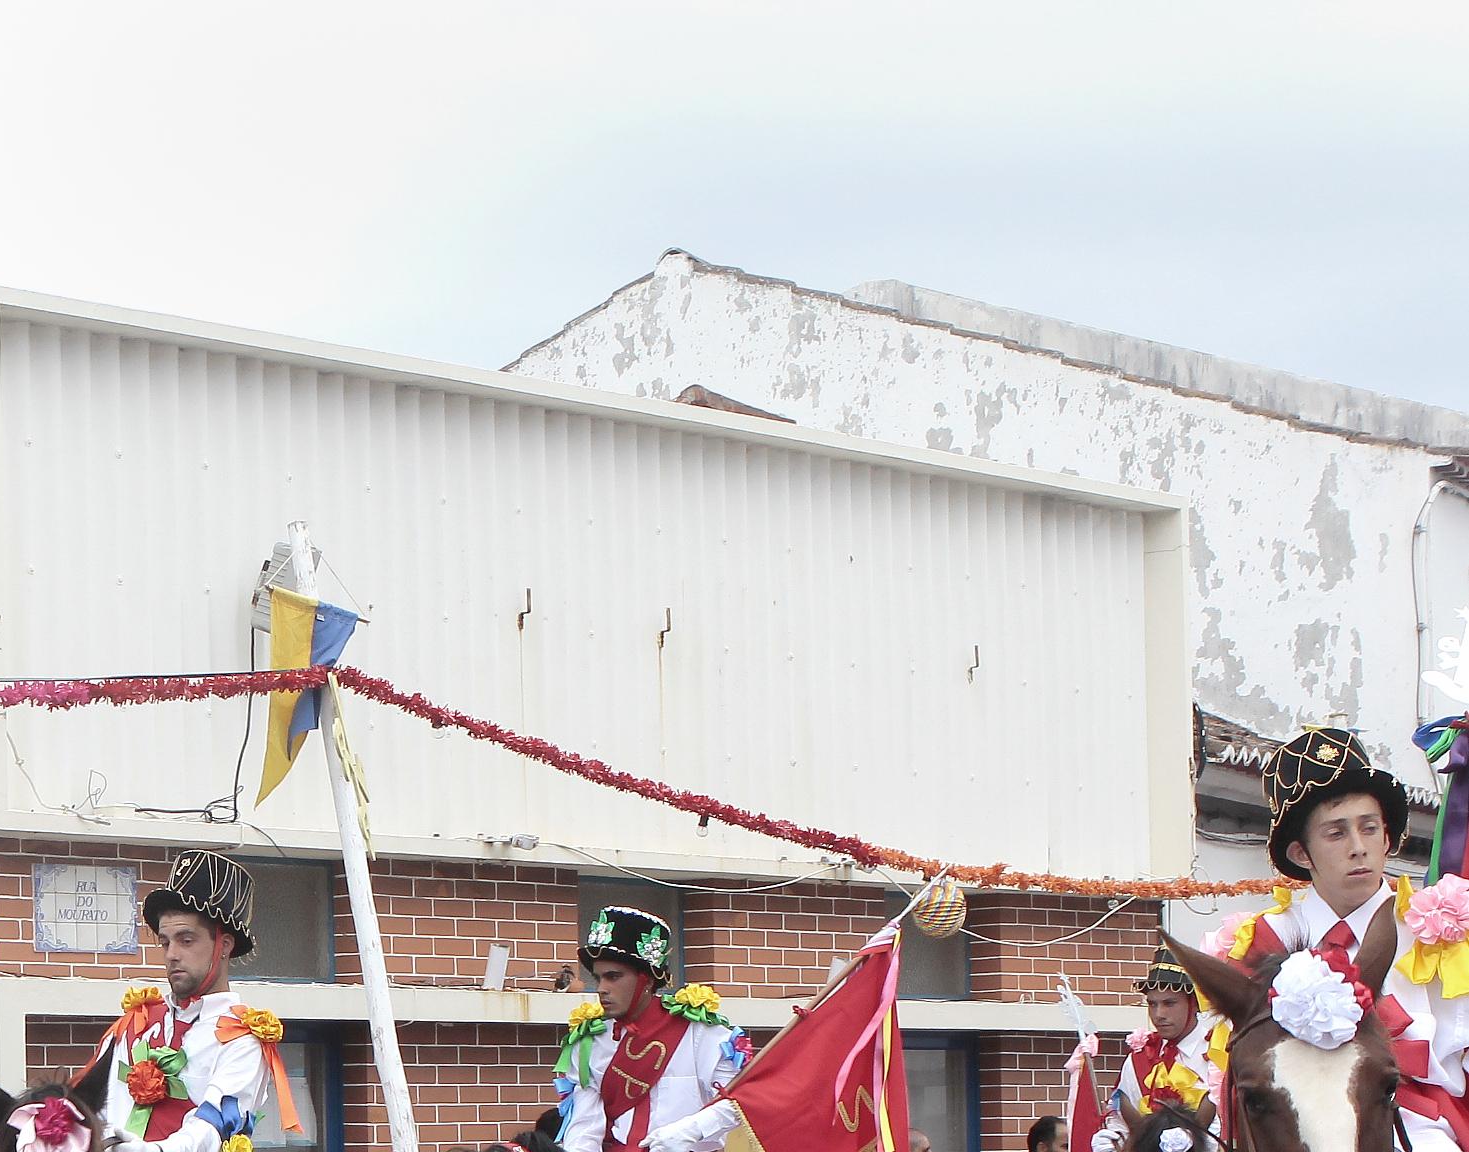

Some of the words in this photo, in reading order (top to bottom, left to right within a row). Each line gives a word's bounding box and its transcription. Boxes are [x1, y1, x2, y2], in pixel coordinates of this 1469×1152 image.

[76, 881, 98, 893] RUA
[76, 896, 93, 907] DO
[57, 909, 108, 921] MOURATO
